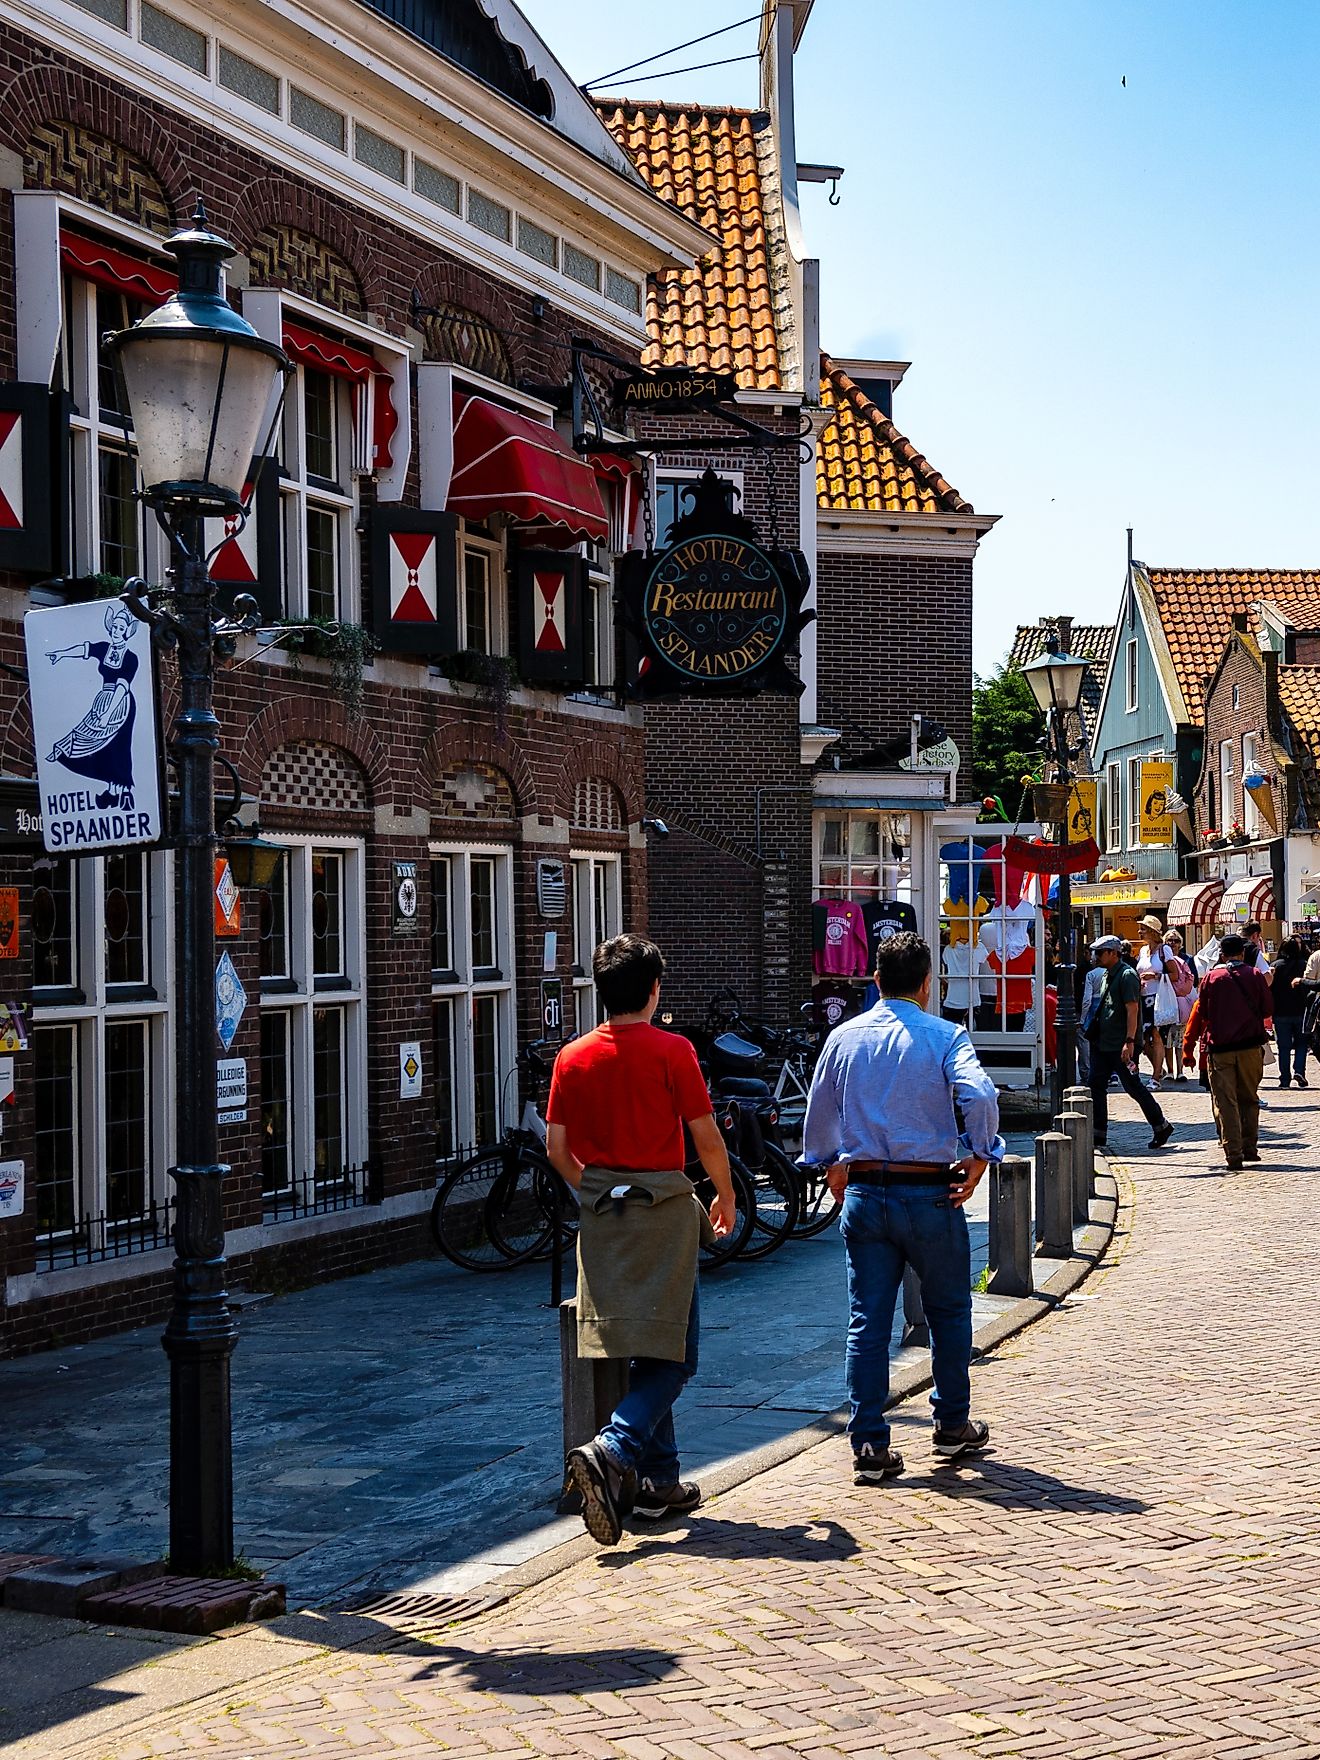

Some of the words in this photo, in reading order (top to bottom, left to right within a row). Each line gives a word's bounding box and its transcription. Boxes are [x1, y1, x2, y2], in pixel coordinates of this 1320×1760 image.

[674, 540, 748, 571] HOTEL
[650, 582, 779, 614] Restaurant
[659, 630, 775, 676] SPAANDER
[922, 749, 956, 762] actory
[47, 790, 97, 816] HOTEL
[15, 809, 44, 834] Hot
[50, 812, 152, 847] SPAANDER
[872, 919, 904, 931] AMSTERDAM
[216, 1066, 245, 1081] OLLEDIGE
[216, 1083, 246, 1098] ERGUNNING
[219, 1111, 244, 1122] SCHILDER
